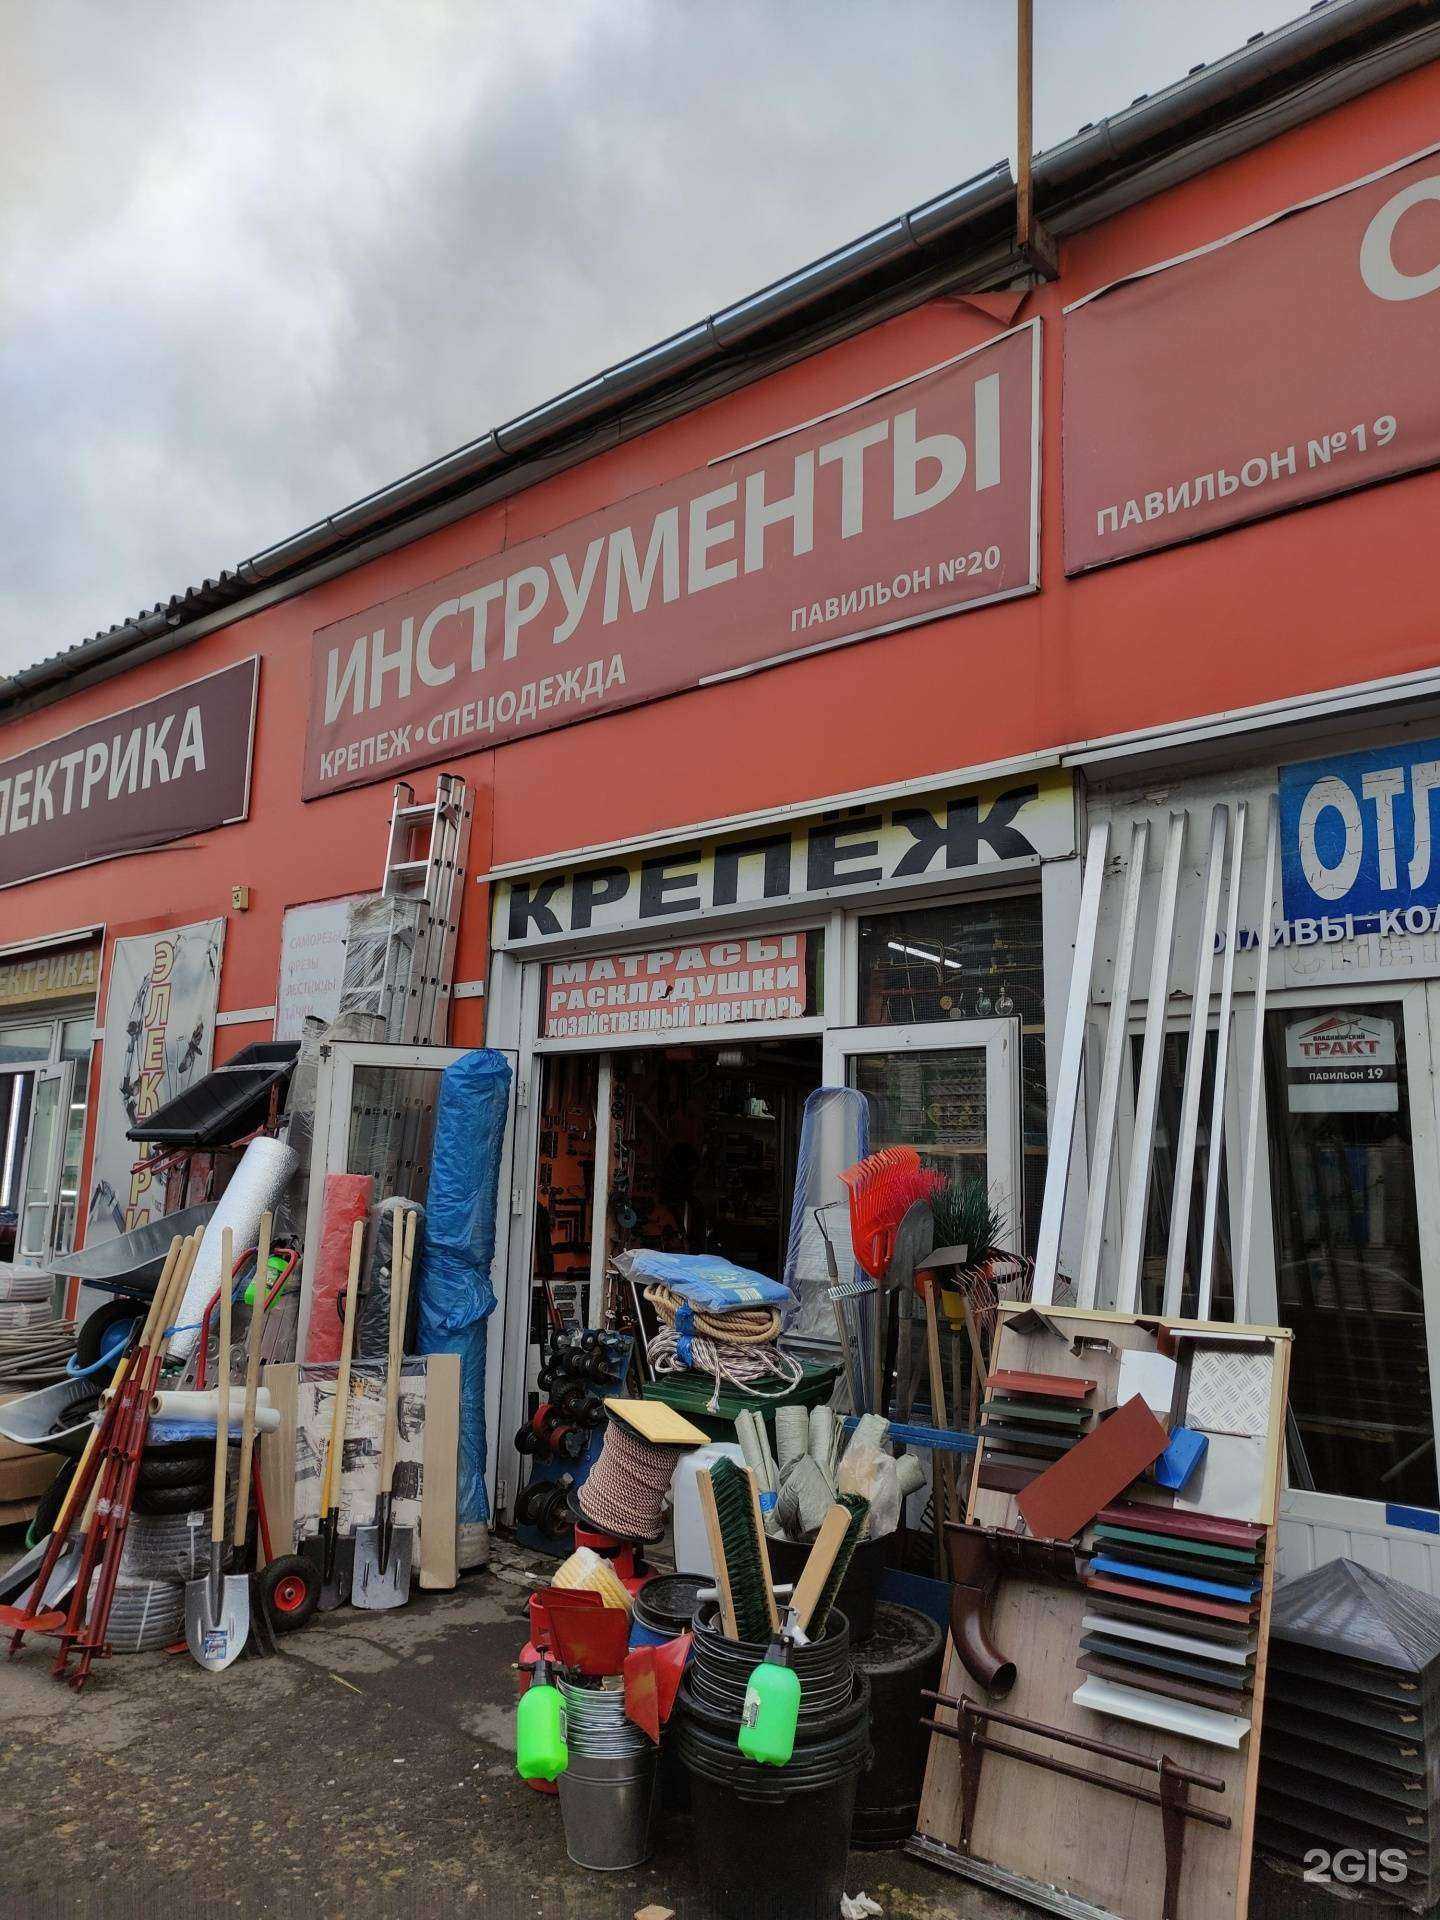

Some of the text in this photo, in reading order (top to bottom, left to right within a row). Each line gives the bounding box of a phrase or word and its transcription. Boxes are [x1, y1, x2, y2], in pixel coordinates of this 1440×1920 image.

[1097, 415, 1397, 536] ПАВИЛЬОН №19
[324, 372, 1001, 726] ИНСТРУМЕНТЫ
[791, 545, 1001, 632] ПАВИЛЬОН №20
[319, 654, 627, 781] КРЕПЕЖ СПЕЦОДЕЖДА
[508, 783, 1039, 941] КРЕПЁЖ
[1379, 904, 1440, 938] КО
[552, 935, 797, 985] МАТРАСЫ
[550, 965, 798, 1012] РАСКЛАДУШКИ
[549, 995, 803, 1037] ХОЗЯЙСТВЕННЫЙ ИНВЕНТАРЬ
[1299, 1040, 1381, 1056] ТРАКТ
[1309, 1067, 1384, 1081] ПАВИЛЬОН 19
